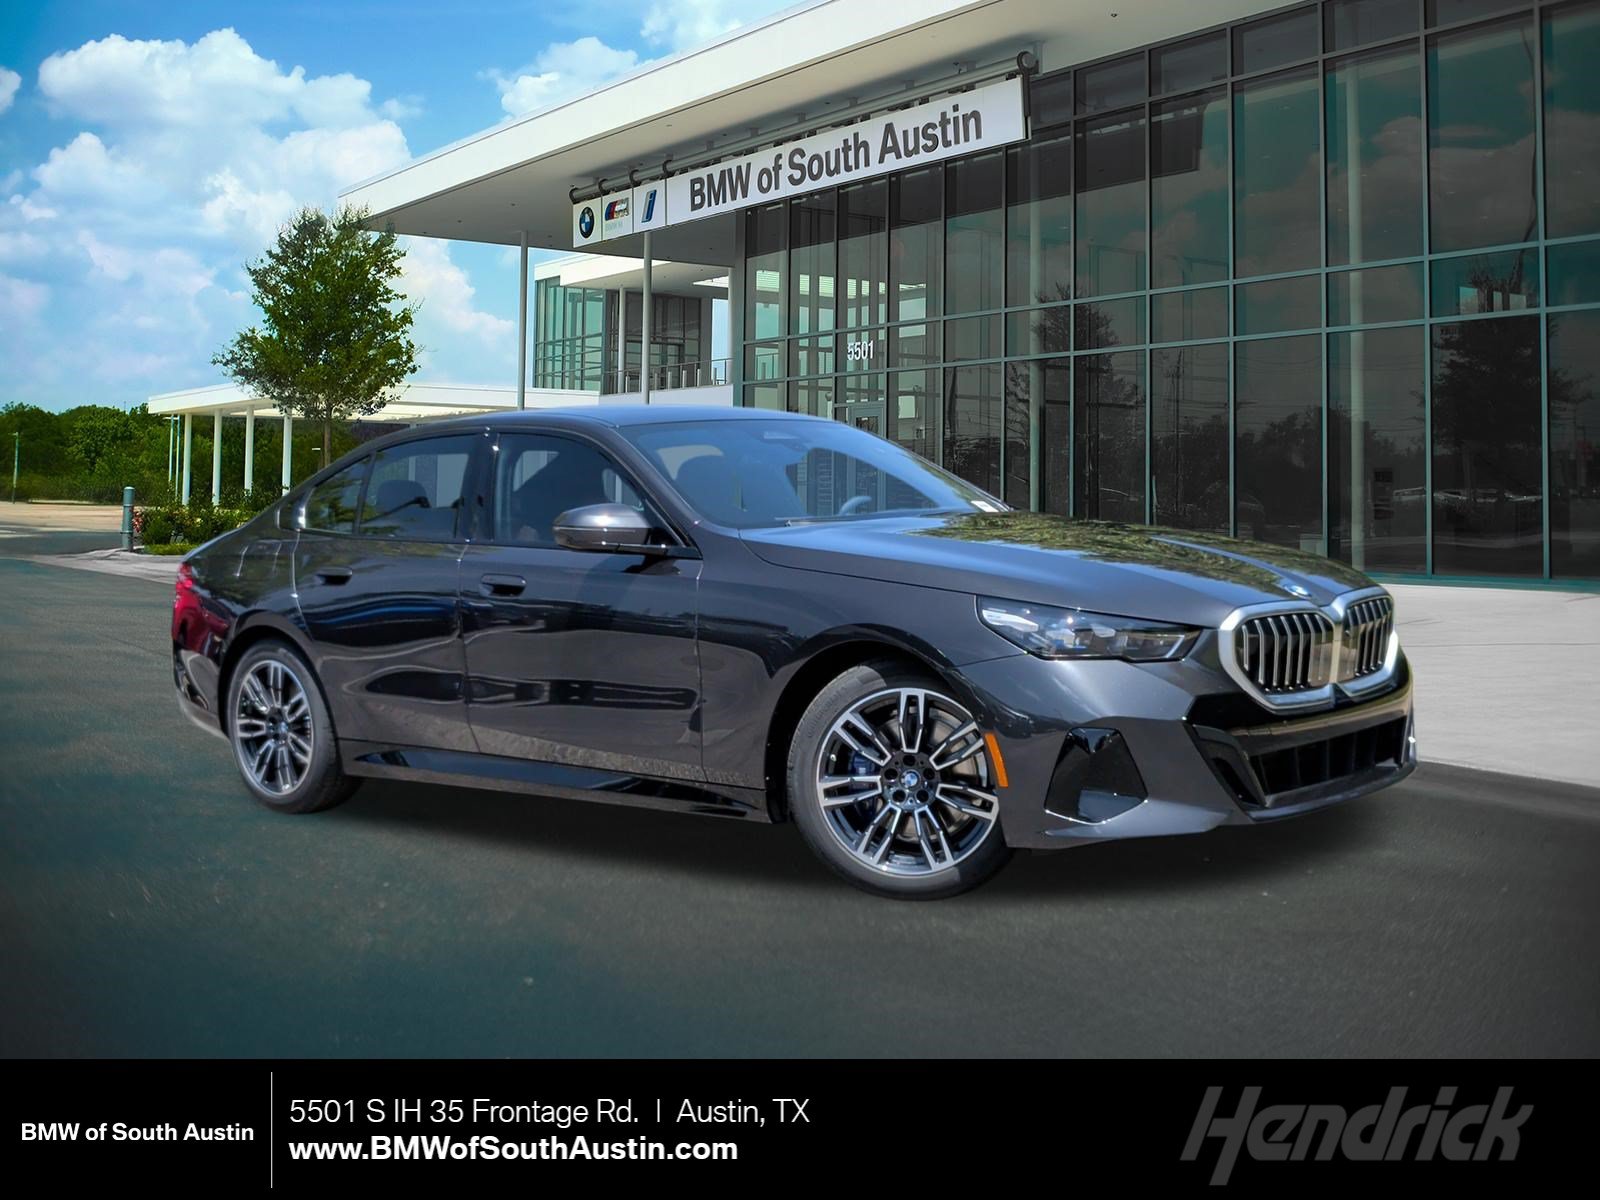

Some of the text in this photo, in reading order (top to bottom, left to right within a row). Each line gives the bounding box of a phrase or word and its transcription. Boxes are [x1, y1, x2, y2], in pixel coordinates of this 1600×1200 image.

[690, 161, 751, 211] BMW
[757, 153, 783, 194] of
[787, 131, 870, 186] South
[878, 103, 982, 164] Austin
[847, 340, 874, 360] 5501
